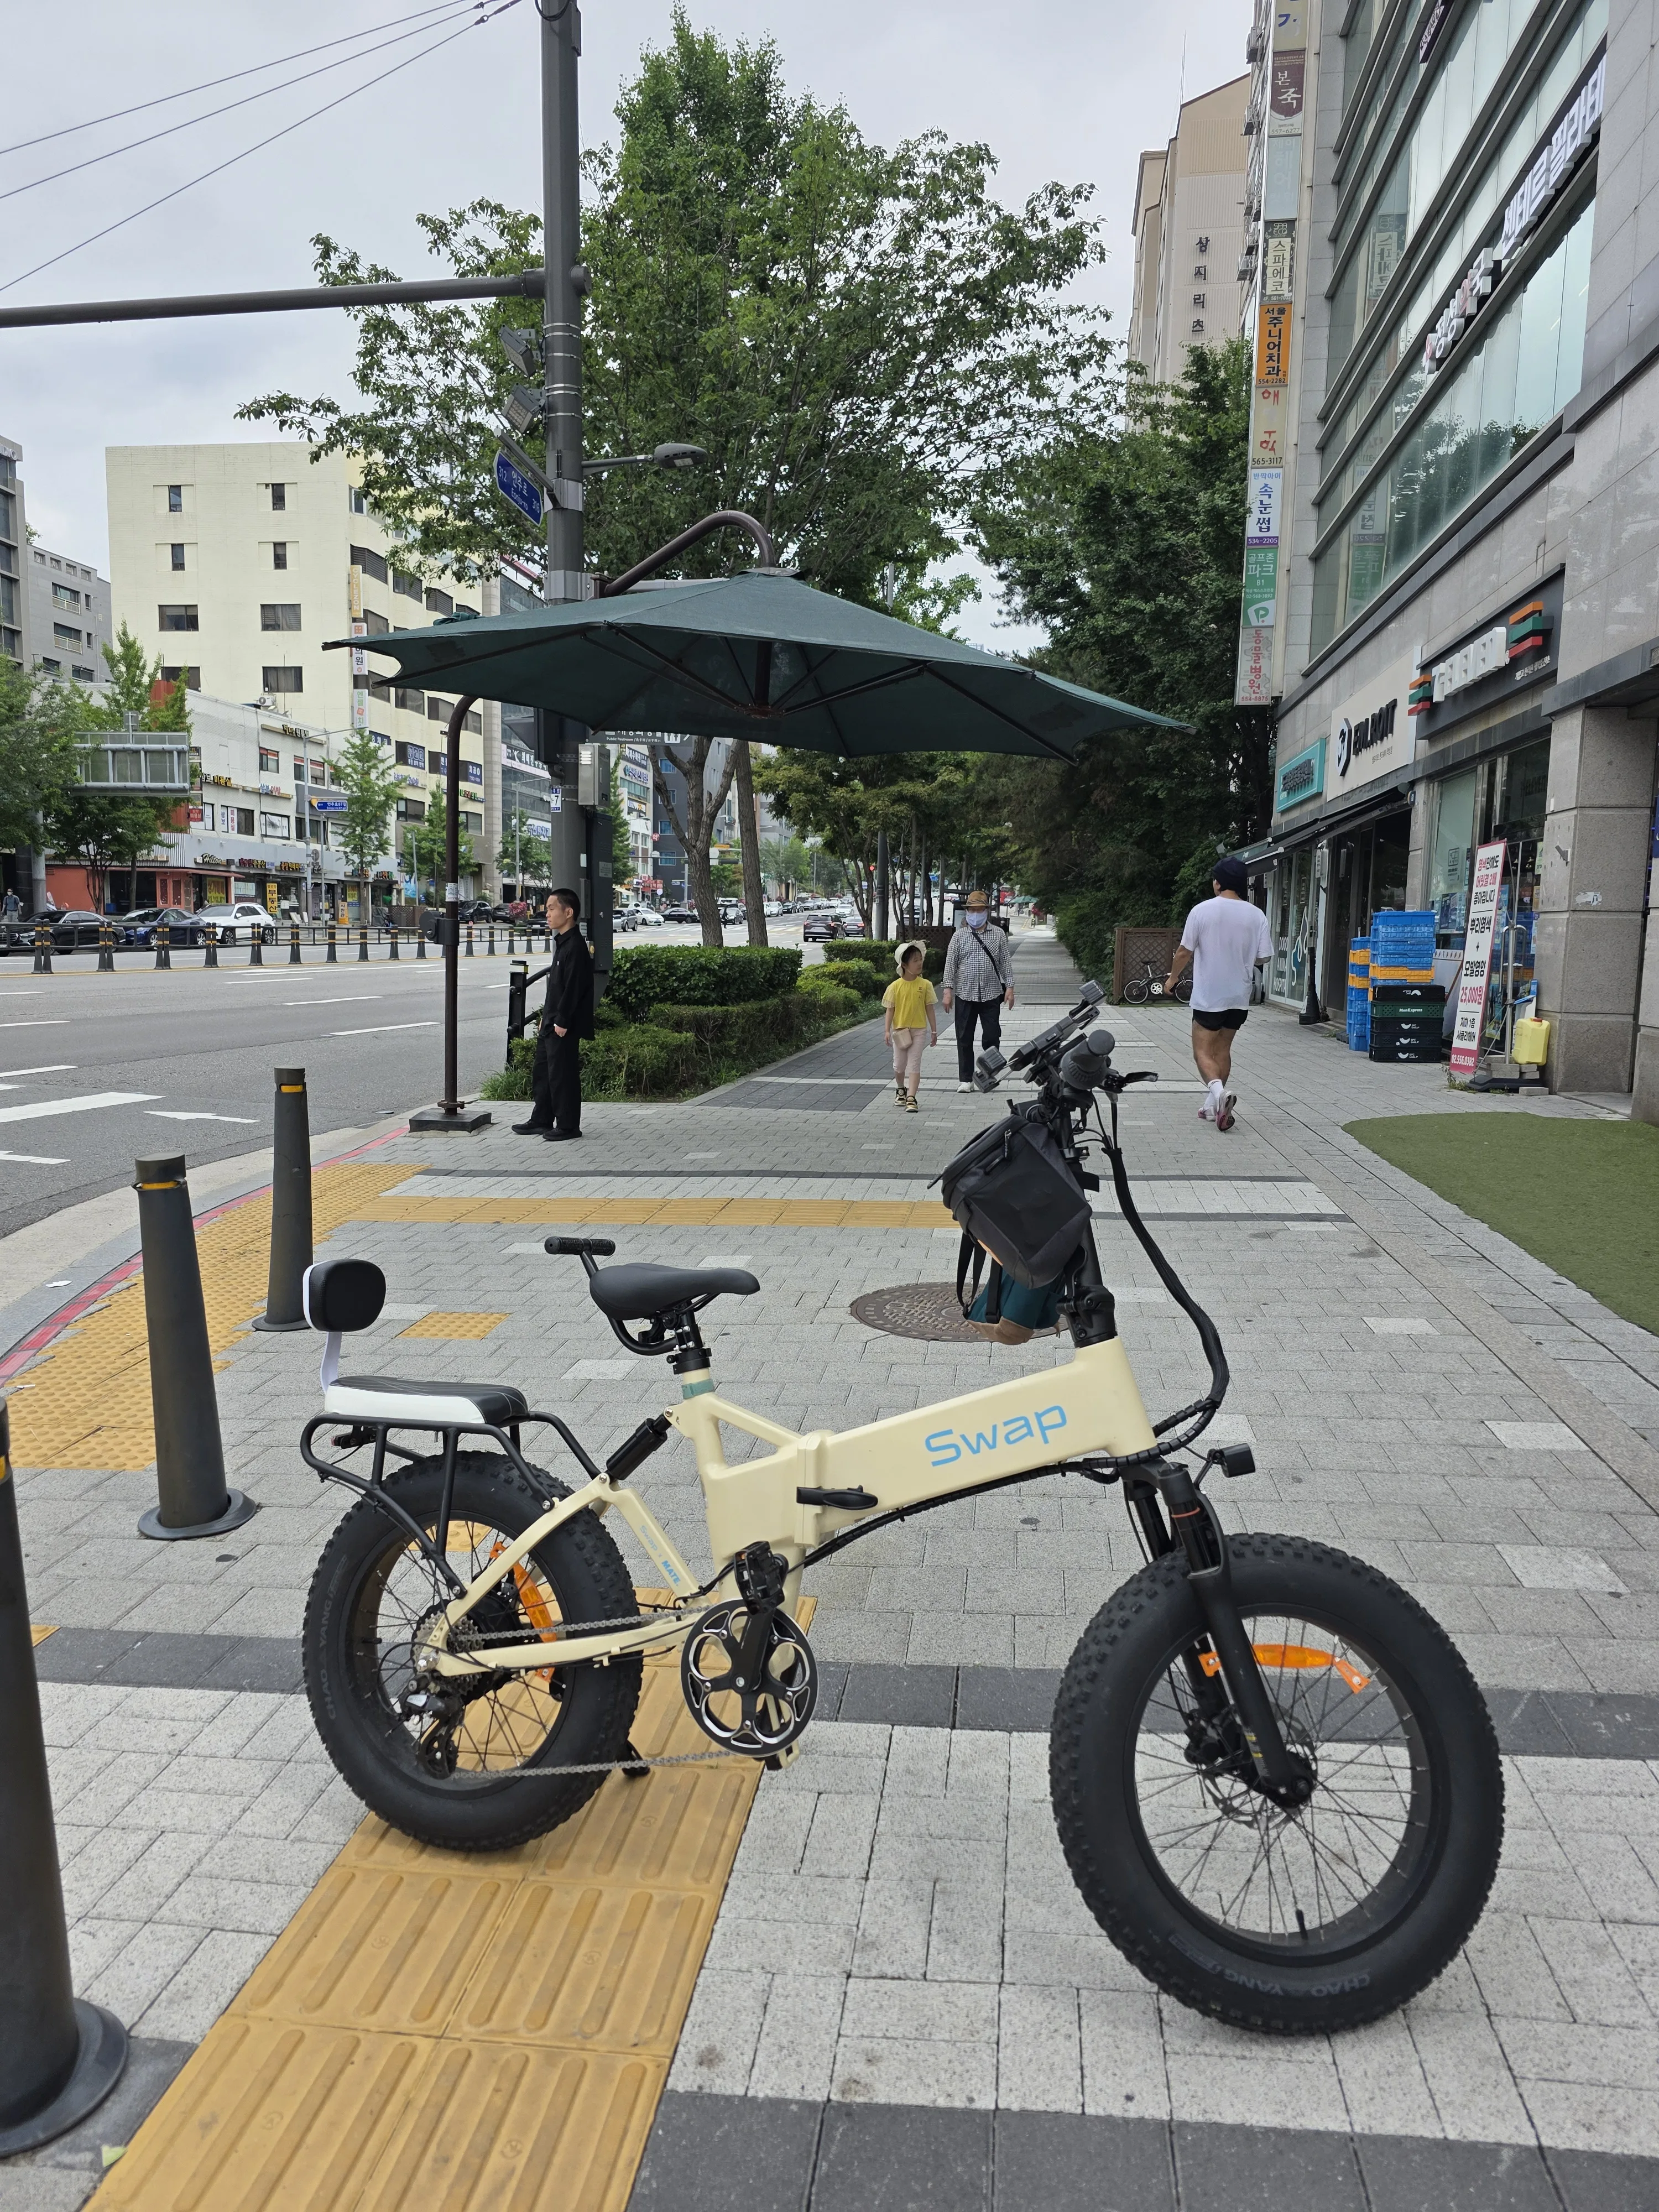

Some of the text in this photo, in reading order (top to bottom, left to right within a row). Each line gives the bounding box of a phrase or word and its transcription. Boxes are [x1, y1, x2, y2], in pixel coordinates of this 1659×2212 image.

[1275, 71, 1301, 109] 본죽
[1271, 241, 1286, 293] 스파에코
[1265, 316, 1283, 377] 주니어치과
[499, 466, 507, 482] 312
[512, 471, 528, 497] 언주로
[511, 487, 528, 510] Eonju-ro
[532, 498, 540, 514] 316
[1256, 483, 1273, 533] 속눈썹
[1248, 553, 1274, 563] 골프존
[1248, 564, 1274, 578] 파크
[1248, 629, 1264, 695] 동물병원
[357, 691, 364, 706] 엔젤
[213, 775, 232, 787] 미용실
[202, 853, 222, 864] Hilton
[1475, 874, 1489, 888] 머릿결
[1473, 889, 1495, 905] 좋아집니다
[1469, 916, 1492, 934] 뿌리염색
[1463, 960, 1486, 977] 모발영양
[1460, 985, 1484, 1005] 25,000원
[1460, 1017, 1475, 1029] 지하 1층
[925, 1405, 1067, 1467] Swap
[640, 1525, 658, 1551] Swap
